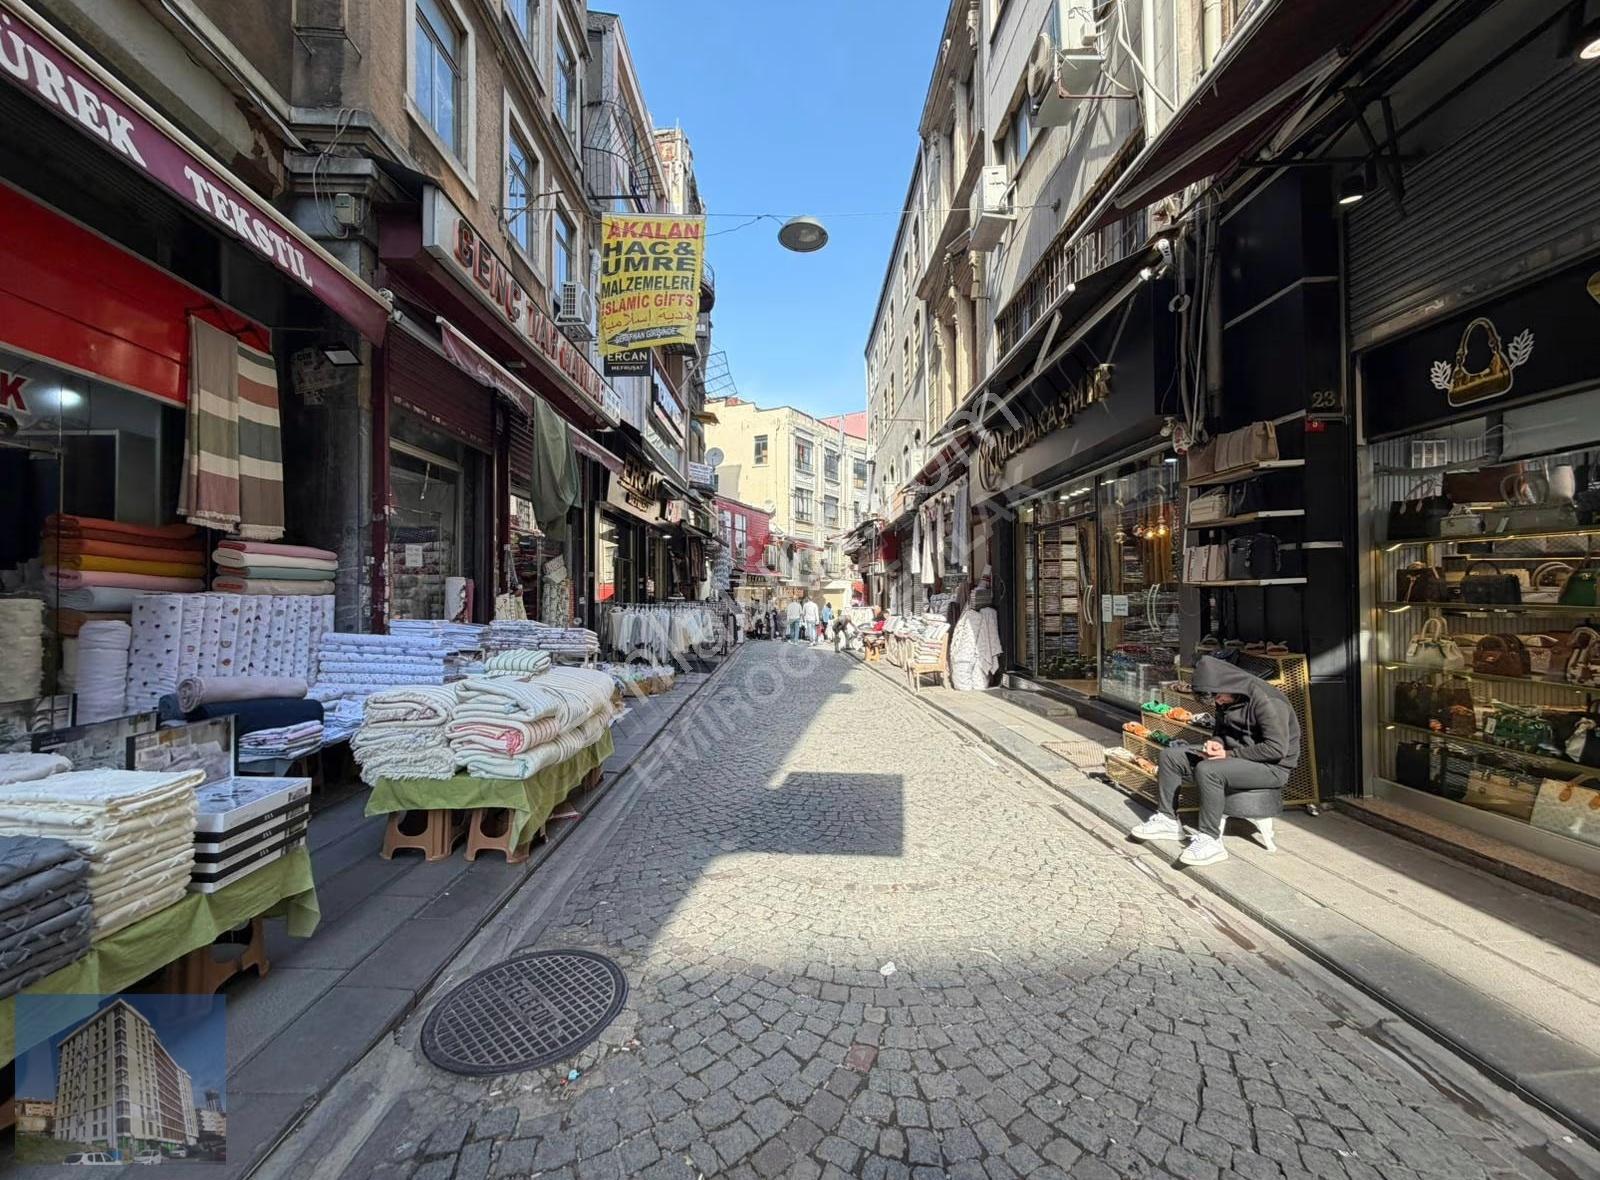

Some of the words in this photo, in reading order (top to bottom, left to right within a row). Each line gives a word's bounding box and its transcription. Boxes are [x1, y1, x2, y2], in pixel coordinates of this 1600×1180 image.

[184, 165, 313, 287] TEKSTİL
[607, 221, 699, 240] AKALAN
[603, 241, 670, 257] HAC
[673, 241, 696, 256] &
[602, 257, 696, 276] UMRE
[601, 274, 694, 298] MALZEMELERİ
[607, 352, 648, 362] ERCAN
[1313, 391, 1335, 407] 23
[504, 979, 557, 1029] TELEFON
